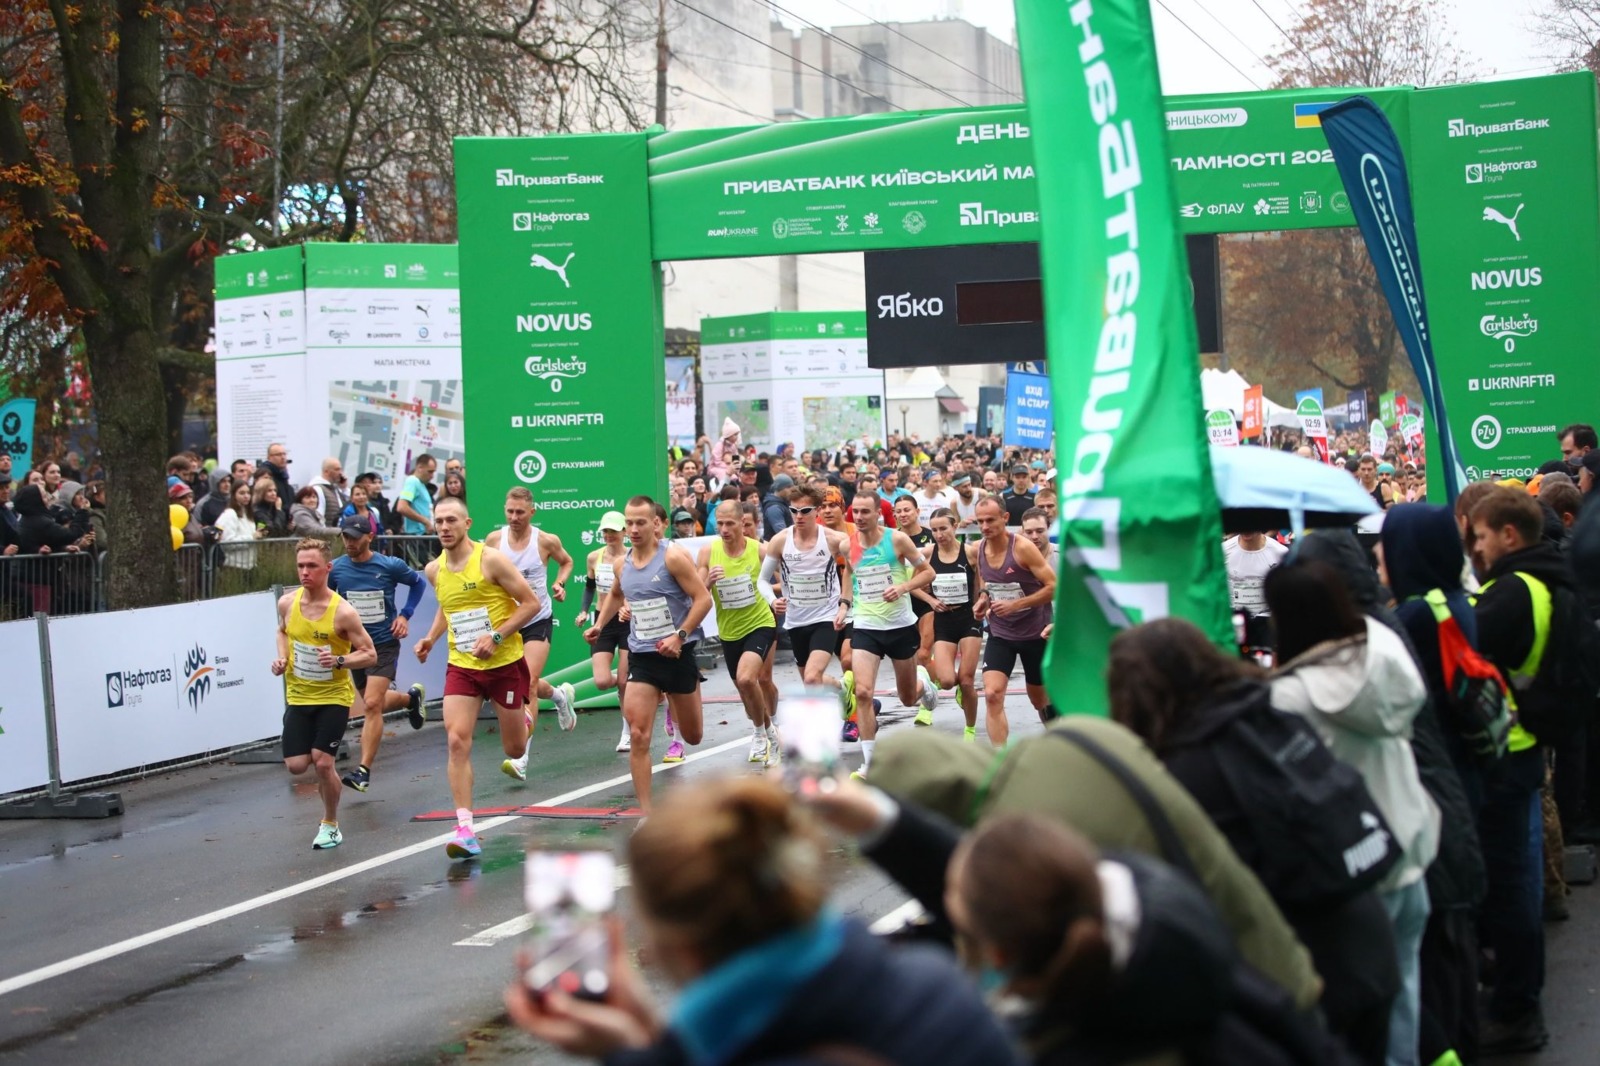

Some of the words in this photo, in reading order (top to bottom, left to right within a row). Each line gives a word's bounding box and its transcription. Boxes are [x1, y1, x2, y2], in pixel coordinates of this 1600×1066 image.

[957, 122, 1030, 145] ДЕНЬ
[1465, 118, 1550, 138] ПриватБанк
[1291, 149, 1335, 166] 202
[1484, 160, 1537, 176] Нафтогаз
[514, 172, 604, 188] ПриватБанк
[723, 174, 867, 196] ПРИВАТБАНК
[871, 163, 998, 188] КИЇВСЬКИЙ
[1484, 175, 1503, 184] Група
[533, 211, 590, 223] Нафтогаз
[1207, 203, 1245, 215] ФЛАУ
[533, 223, 553, 232] Група
[1471, 267, 1542, 291] NOVUS
[877, 292, 943, 319] Ябко
[516, 312, 592, 333] NOVUS
[1479, 312, 1539, 340] Carlsberg
[524, 355, 587, 380] Carlsberg
[1482, 374, 1556, 390] UKRNAFTA
[526, 413, 604, 428] UKRNAFTA
[1478, 424, 1495, 440] PZU
[1506, 425, 1557, 435] СТРАХУВАННЯ
[521, 459, 540, 474] PZU
[552, 460, 604, 470] СТРАХУВАННЯ
[532, 499, 615, 510] NERGOATOM
[123, 668, 172, 689] Нафтогаз
